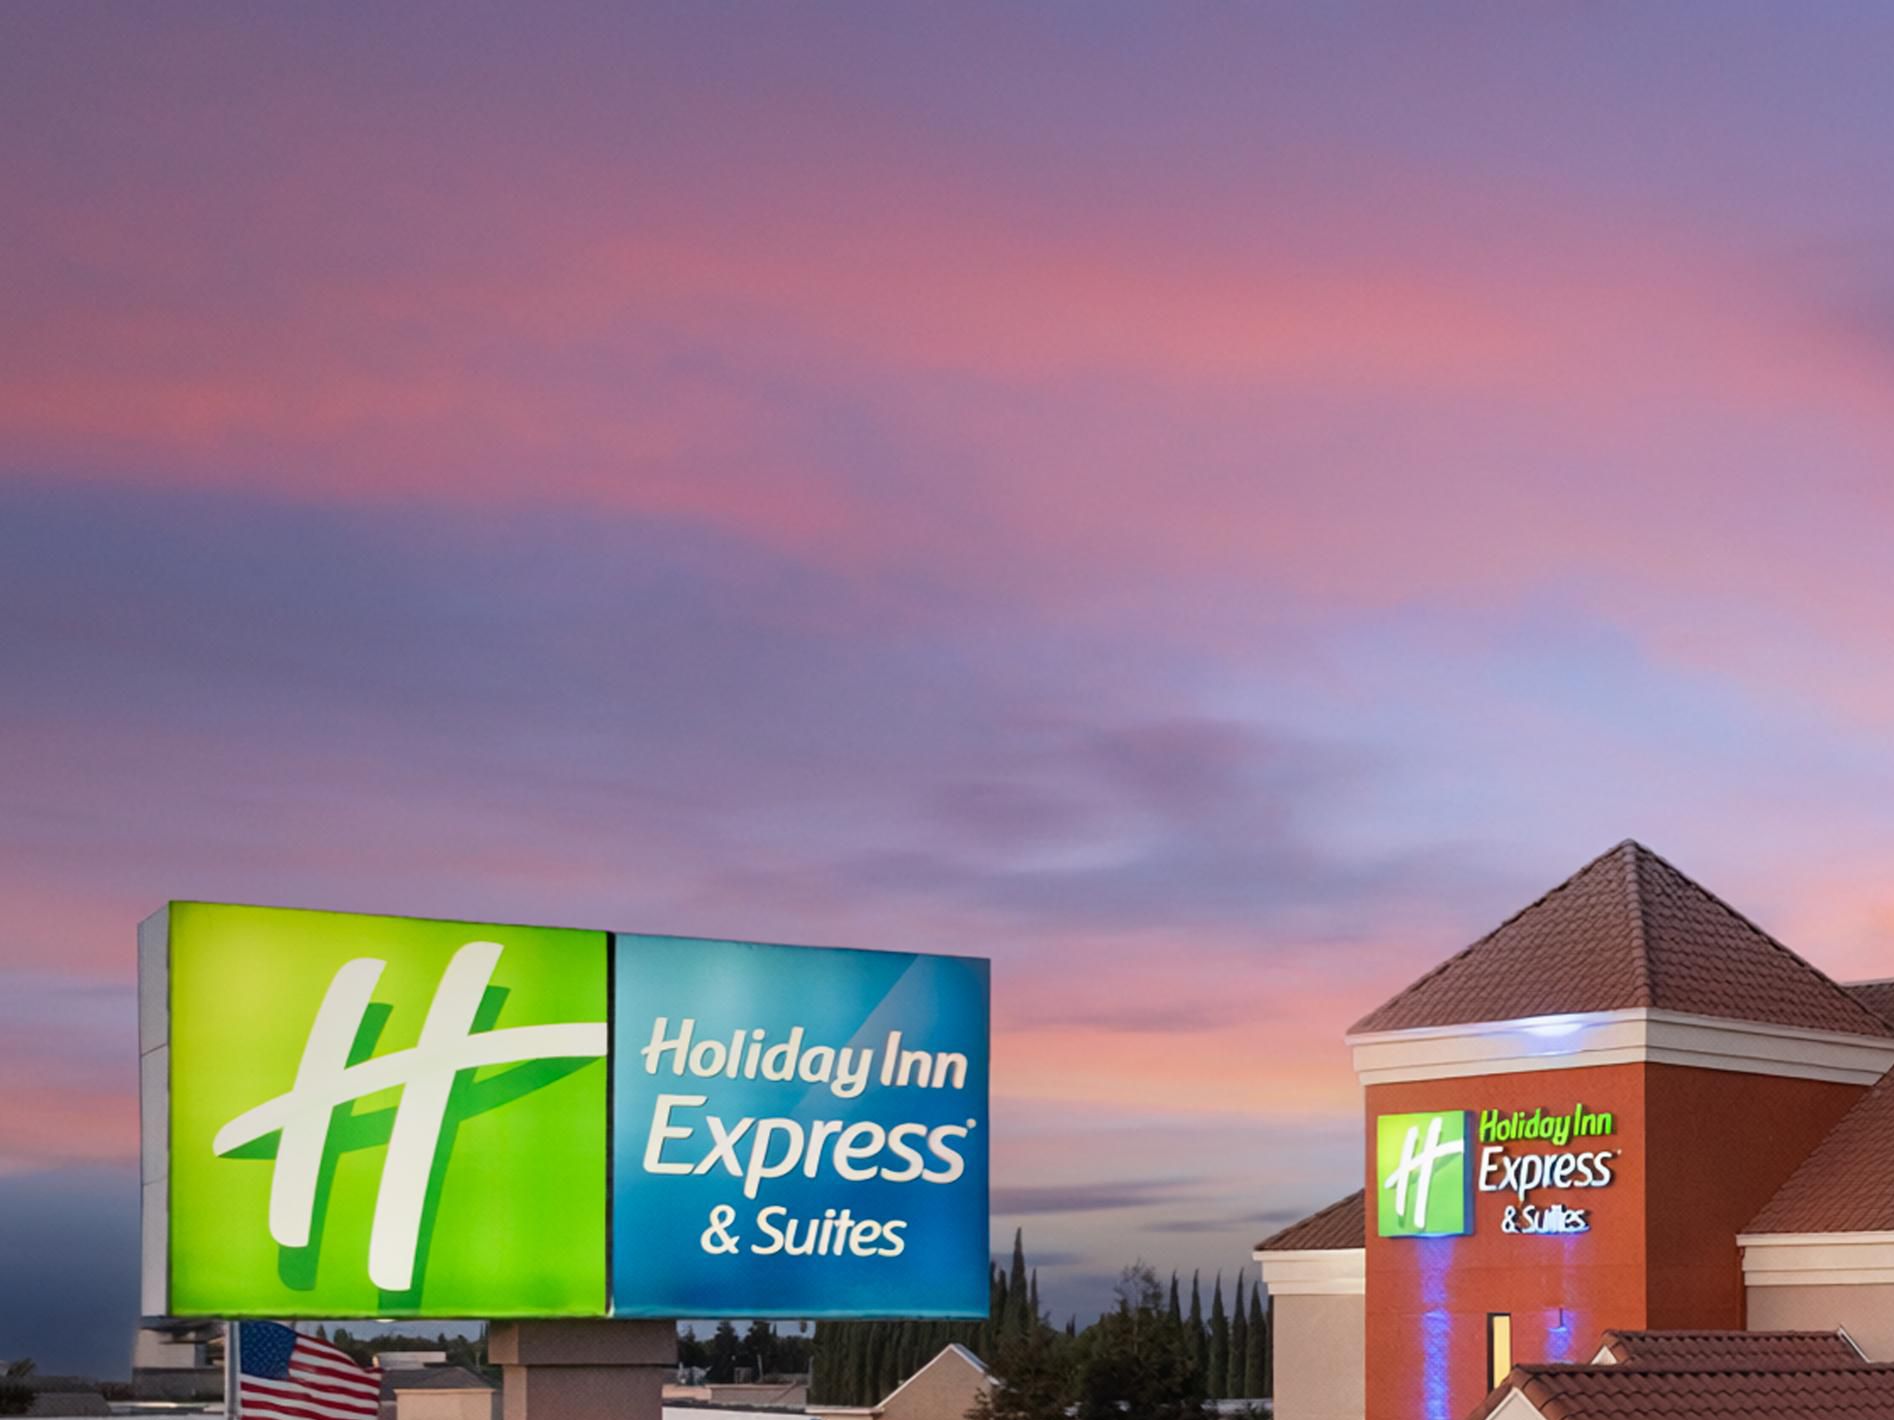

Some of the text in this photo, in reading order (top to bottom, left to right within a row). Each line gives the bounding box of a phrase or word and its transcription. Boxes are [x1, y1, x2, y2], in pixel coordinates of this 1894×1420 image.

[640, 1017, 968, 1098] Holiday Inn
[641, 1094, 968, 1199] Express
[1479, 1103, 1612, 1145] Holiday Inn
[1479, 1146, 1614, 1201] Express
[700, 1205, 908, 1258] & Suites
[1502, 1204, 1589, 1233] & Suites
